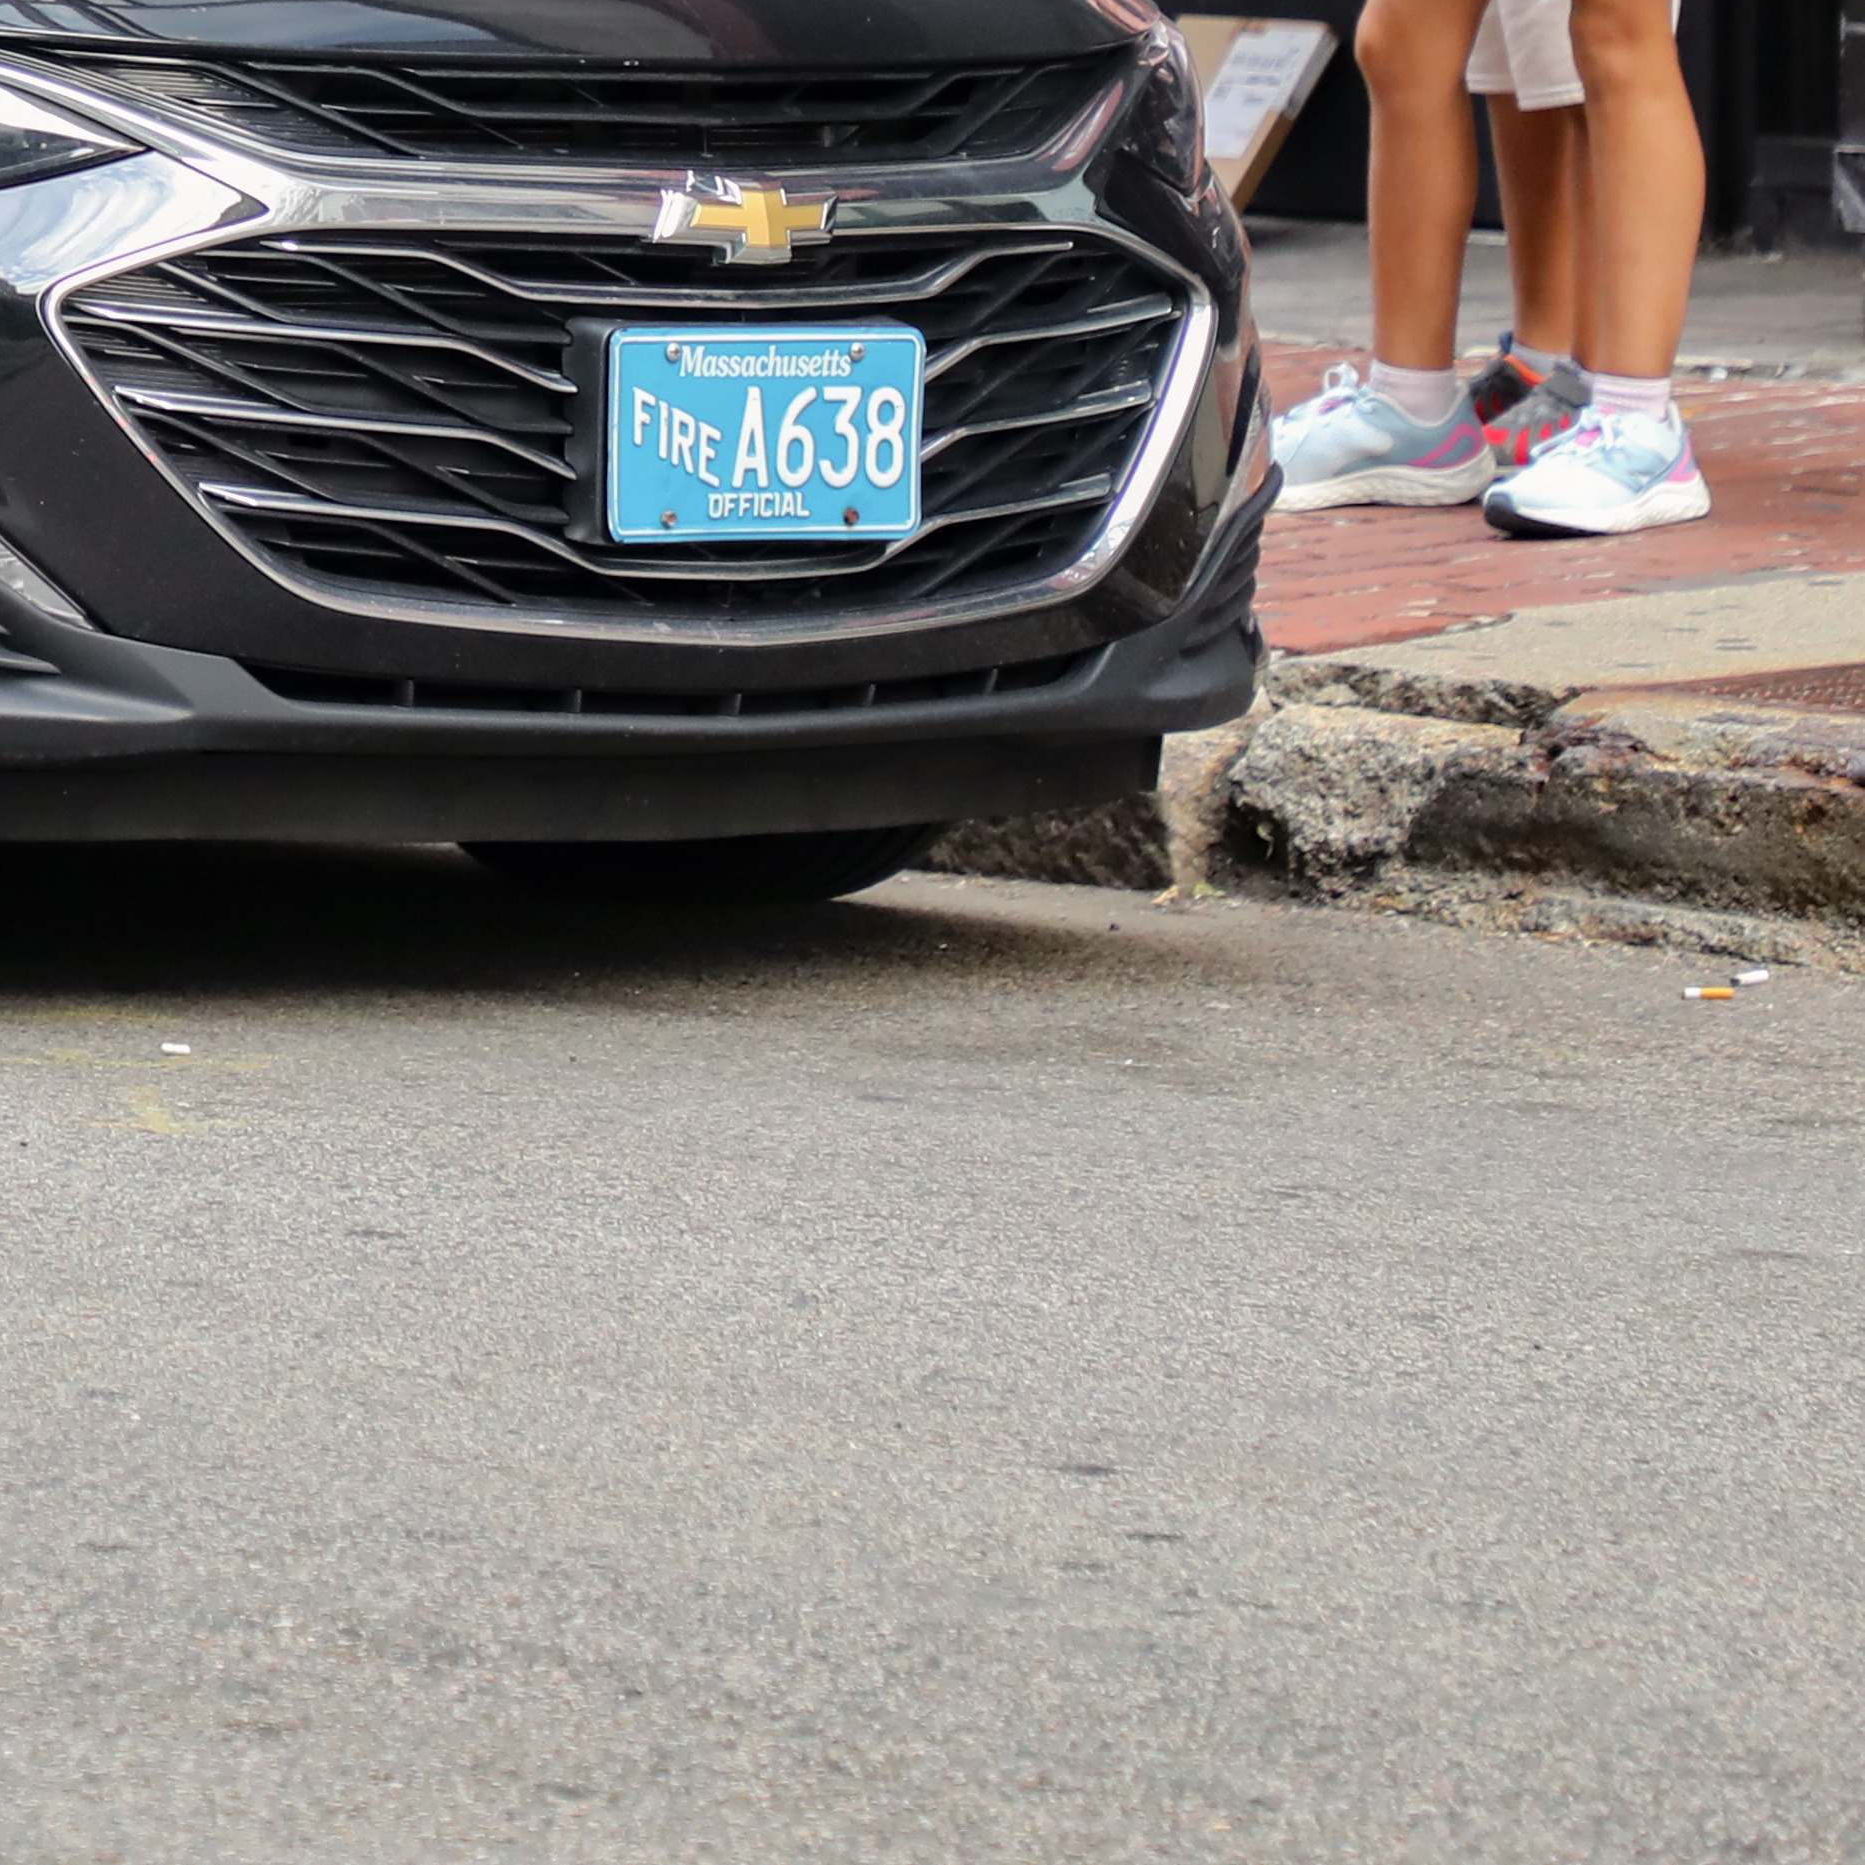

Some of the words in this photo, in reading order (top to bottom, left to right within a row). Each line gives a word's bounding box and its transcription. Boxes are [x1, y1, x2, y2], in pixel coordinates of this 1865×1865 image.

[679, 344, 853, 378] Massachusetts
[632, 386, 722, 488] FIRE
[731, 385, 907, 488] A638
[708, 491, 811, 520] OFFICIAL
